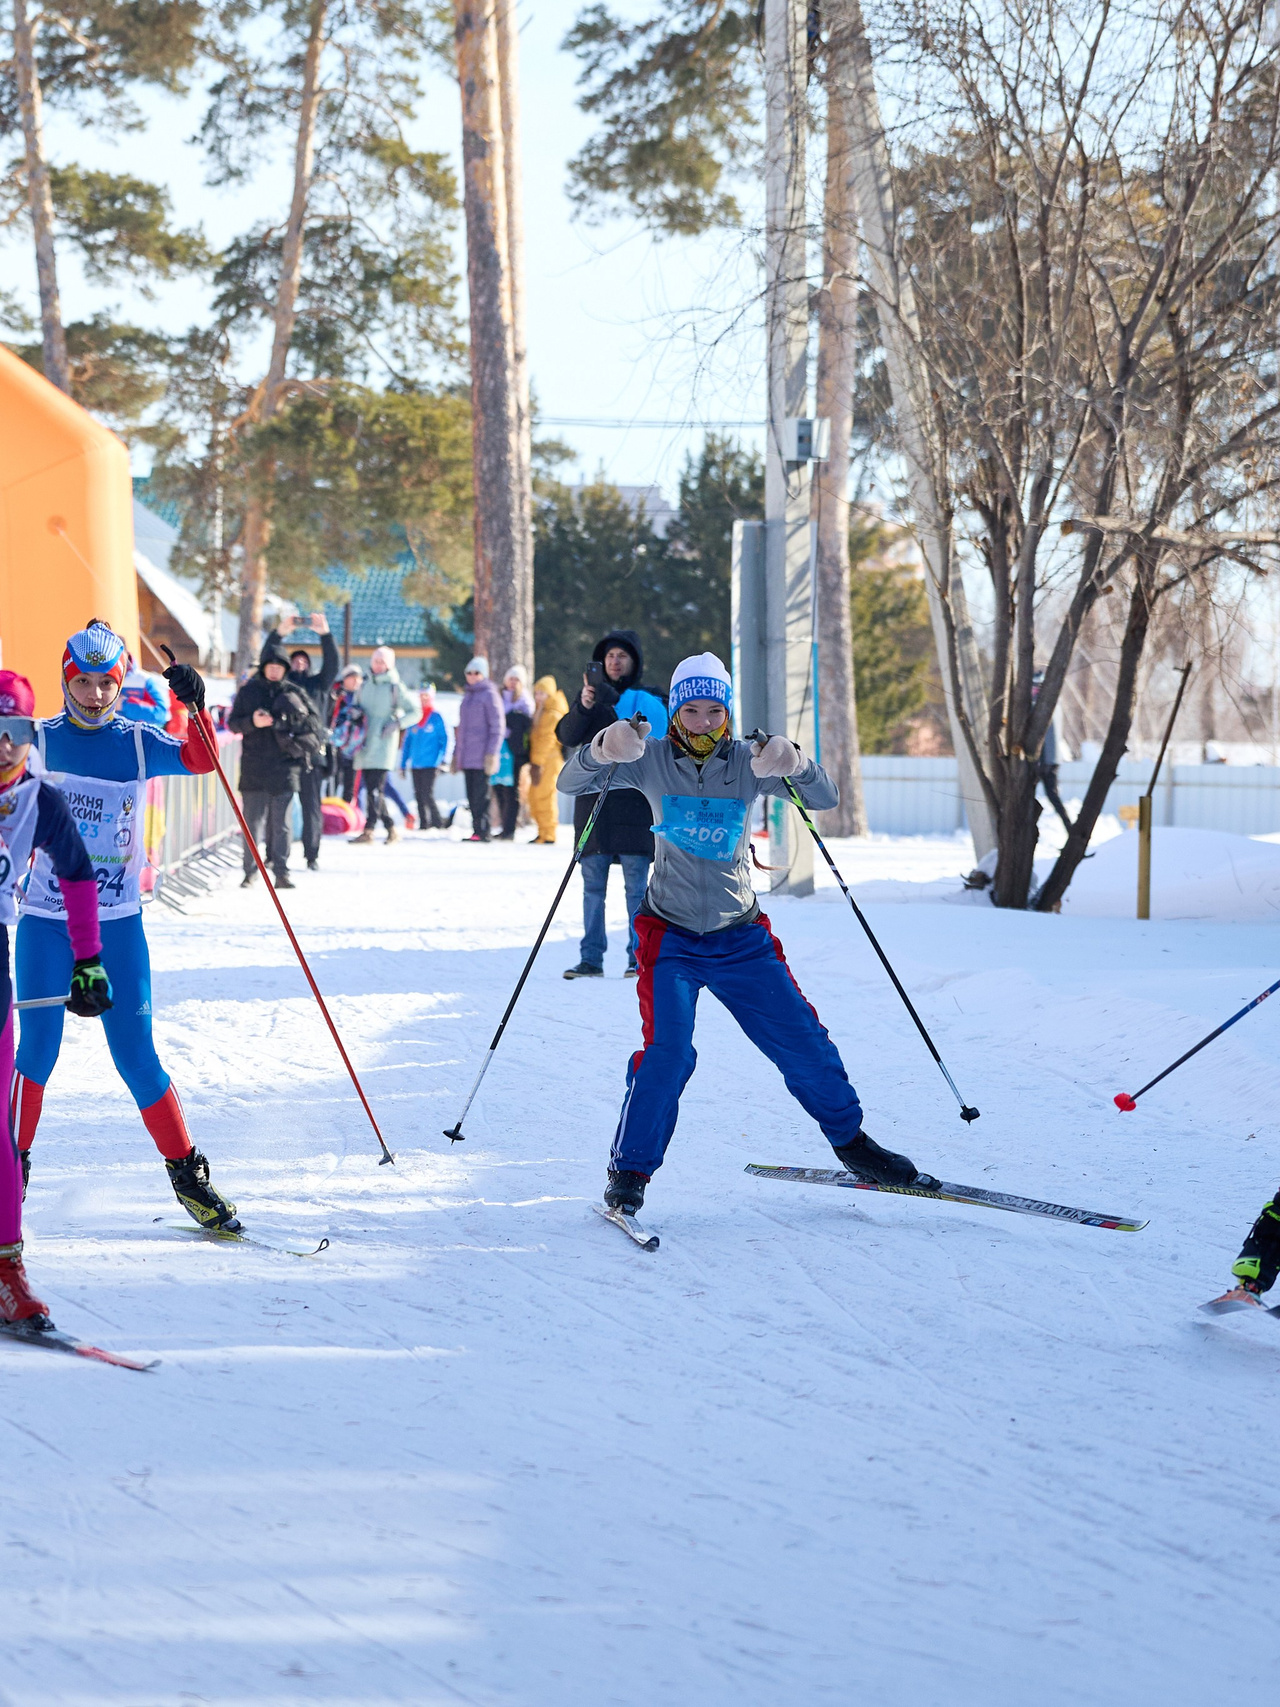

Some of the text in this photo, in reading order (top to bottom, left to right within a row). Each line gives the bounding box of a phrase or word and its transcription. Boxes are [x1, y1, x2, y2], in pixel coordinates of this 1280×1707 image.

[679, 679, 727, 693] ЛЫЖНЯ
[679, 686, 727, 702] РОССИИ
[63, 791, 104, 811] ЫЖНЯ
[71, 806, 102, 823] ССИИ
[78, 821, 99, 839] 23
